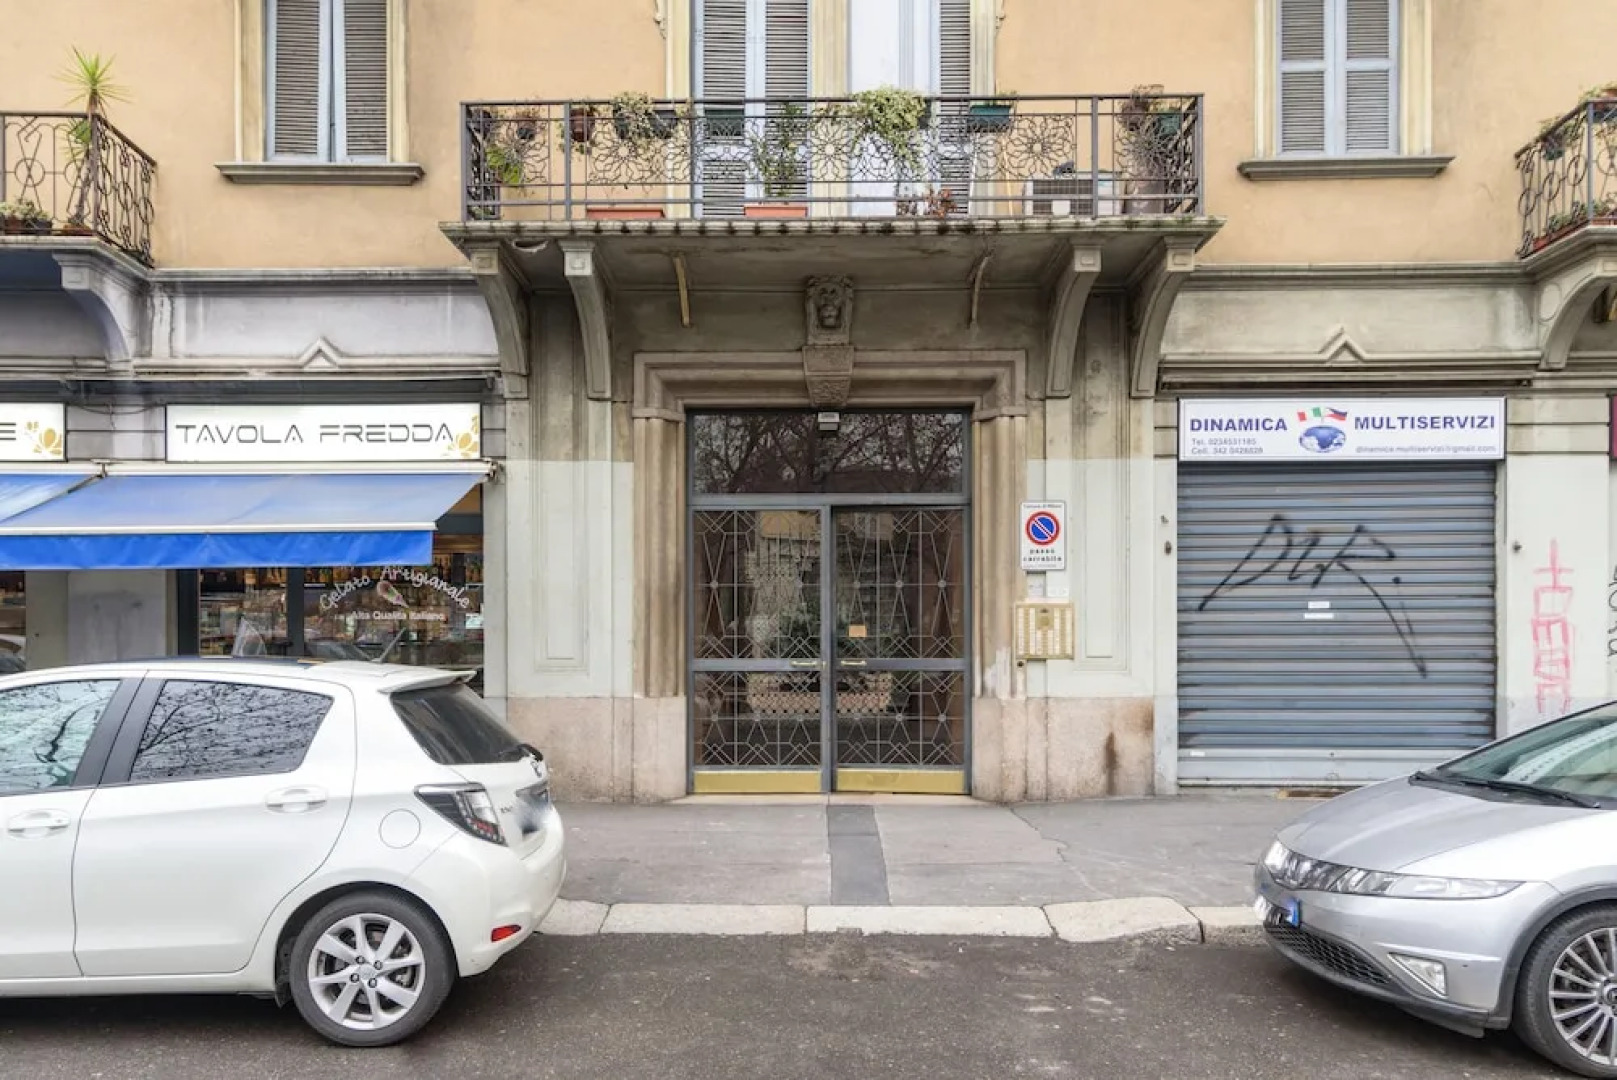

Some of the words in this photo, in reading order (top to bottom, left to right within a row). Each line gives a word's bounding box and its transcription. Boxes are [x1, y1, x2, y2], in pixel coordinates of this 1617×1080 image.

[175, 424, 304, 444] TAVOLA
[319, 423, 454, 442] FREDDA
[1190, 418, 1287, 431] DINAMICA
[1354, 416, 1495, 429] MULTISERVIZI
[319, 574, 371, 612] Gelato
[380, 565, 470, 609] Artigianale
